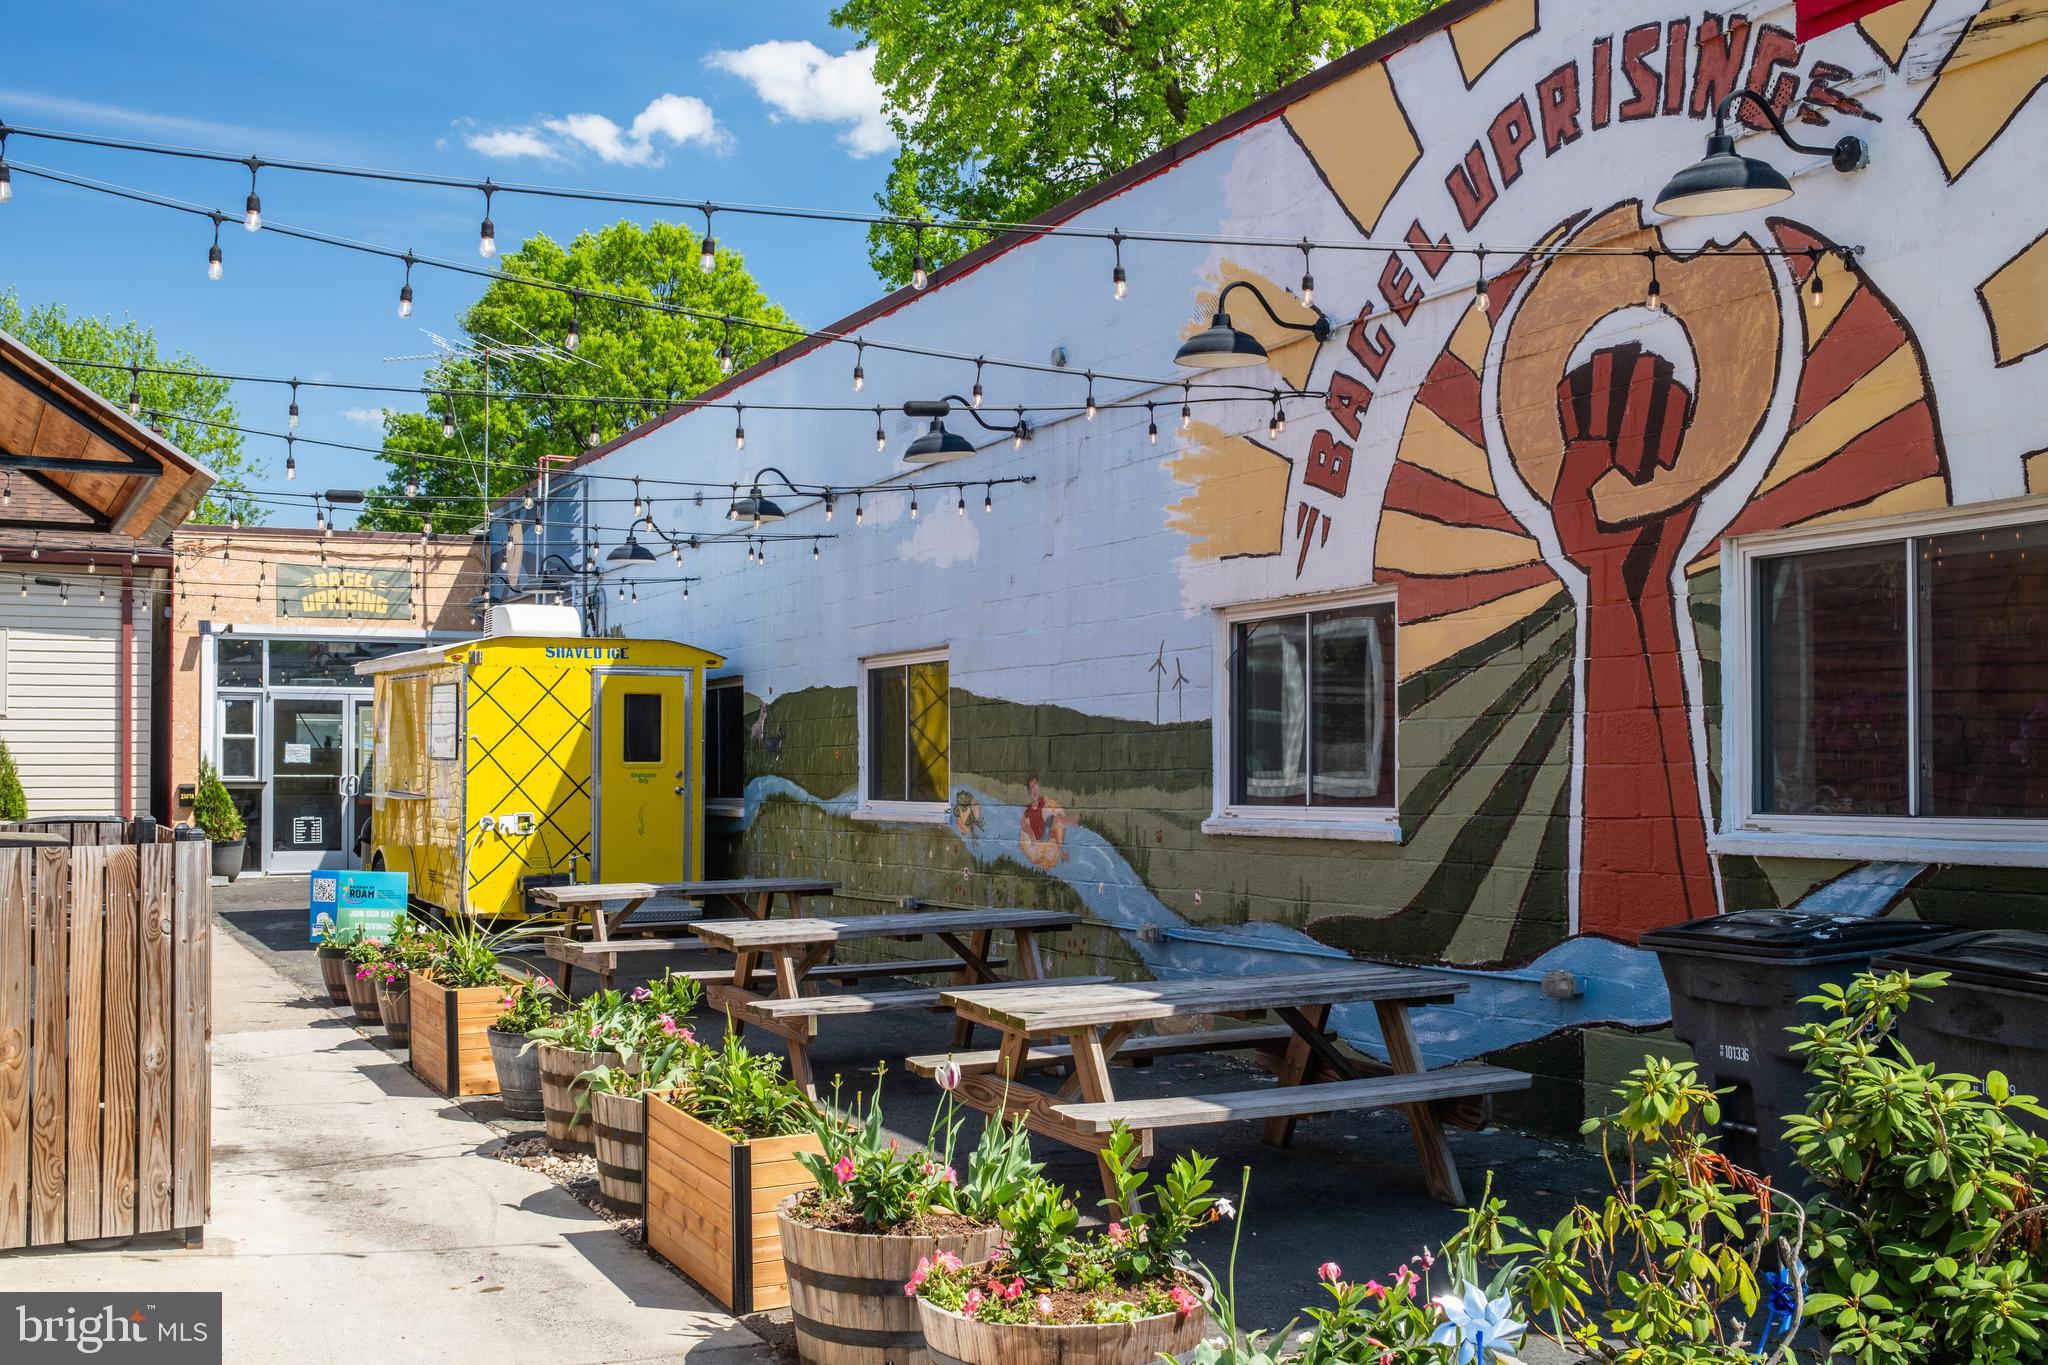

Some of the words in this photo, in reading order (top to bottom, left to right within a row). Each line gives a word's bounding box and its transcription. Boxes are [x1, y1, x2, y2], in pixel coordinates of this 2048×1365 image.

[1303, 217, 1454, 499] BAGEL
[1444, 11, 1805, 232] UPRISING
[313, 572, 375, 590] BAGEL
[302, 589, 389, 614] UPRISING
[545, 645, 603, 659] SHAVED
[606, 646, 629, 660] ICE
[349, 889, 375, 898] ROAM
[349, 910, 365, 918] JOIN
[365, 910, 379, 918] OUR
[380, 910, 394, 918] DAY
[1725, 1045, 1750, 1061] 101336
